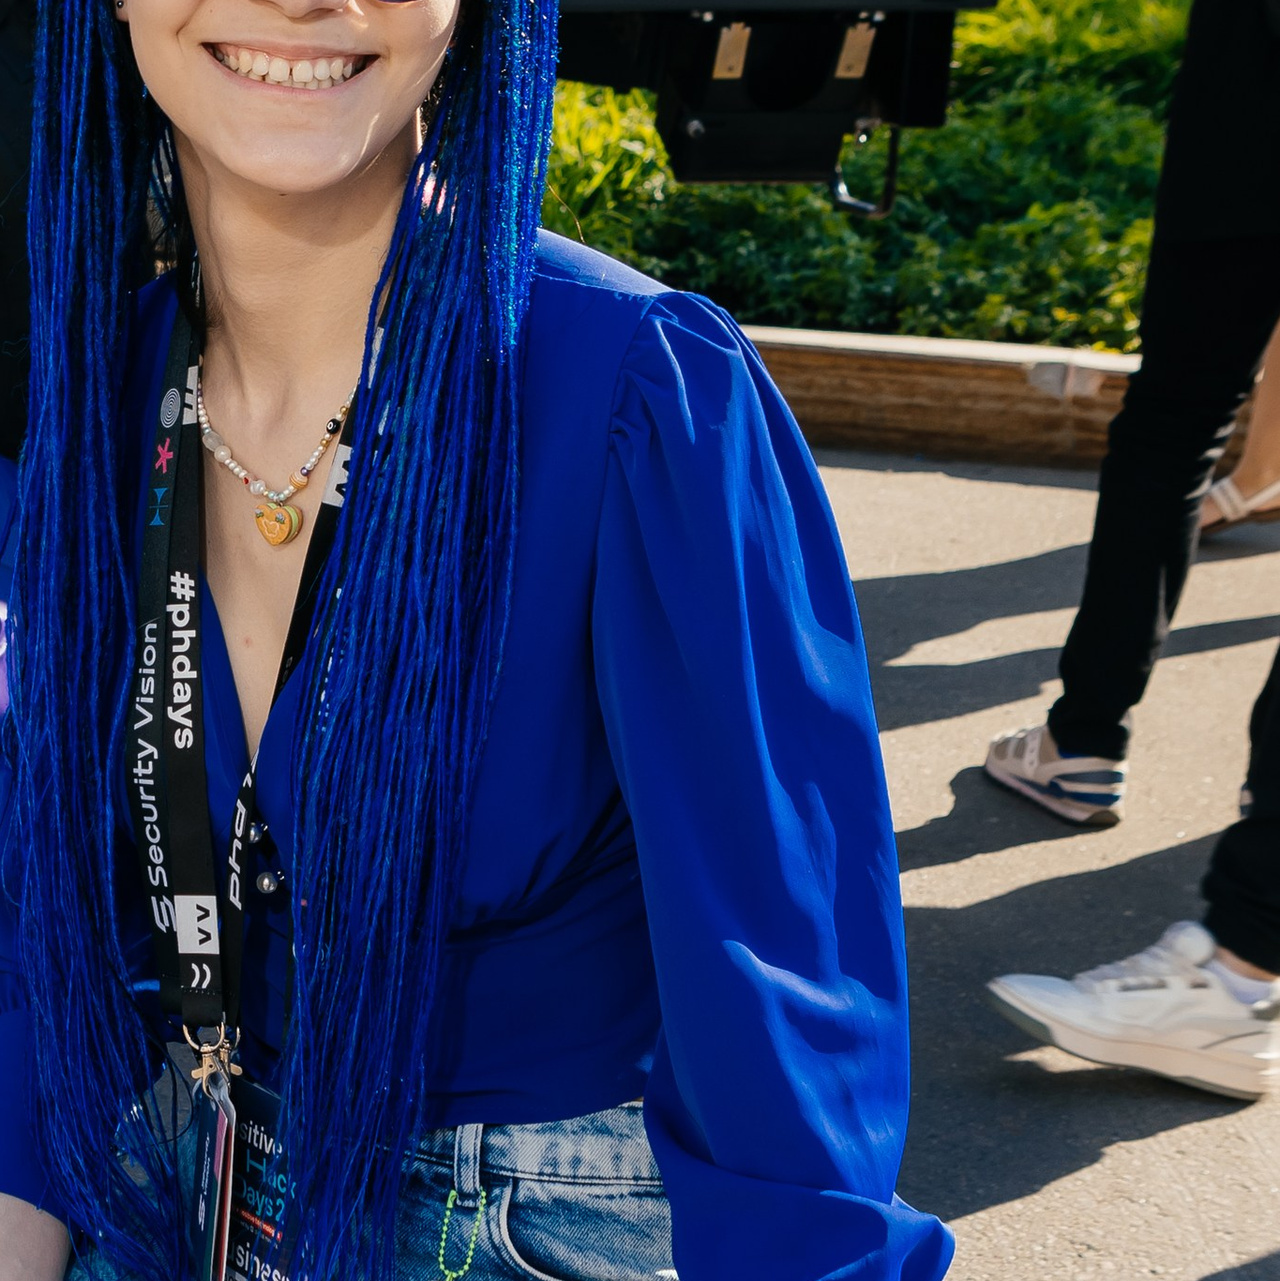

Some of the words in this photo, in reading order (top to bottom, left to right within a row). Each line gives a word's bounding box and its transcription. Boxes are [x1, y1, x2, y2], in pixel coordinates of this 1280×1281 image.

[134, 622, 158, 731] Vision
[166, 571, 197, 749] #phdays
[133, 738, 168, 888] Security
